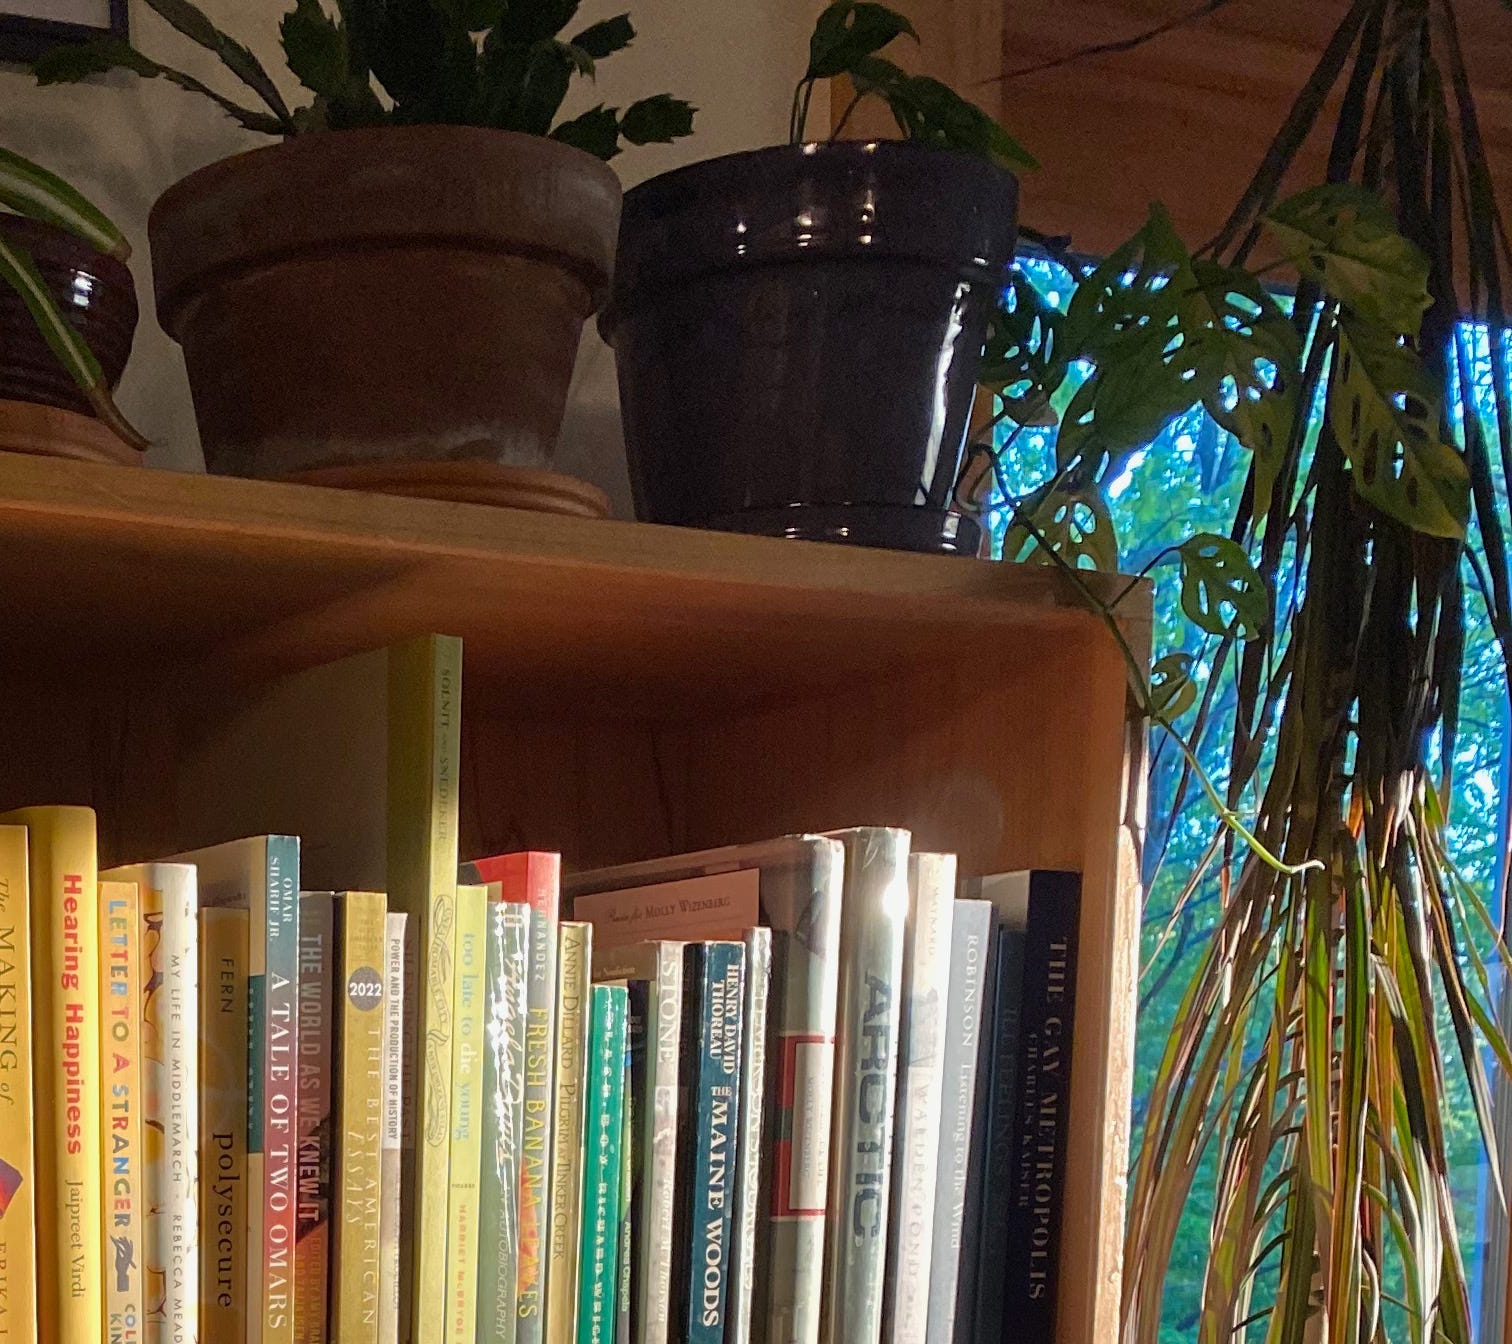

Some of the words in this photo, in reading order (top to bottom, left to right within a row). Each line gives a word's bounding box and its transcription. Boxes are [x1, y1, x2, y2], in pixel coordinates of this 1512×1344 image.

[61, 874, 83, 991] Hearing
[108, 899, 130, 996] LETTER
[271, 972, 290, 995] A
[349, 983, 381, 996] 2022
[110, 1009, 129, 1042] TO
[112, 1053, 131, 1072] A
[270, 1003, 289, 1082] TALE
[0, 1083, 15, 1105] of
[62, 1003, 85, 1155] Happiness
[270, 1094, 289, 1134] OF
[112, 1084, 131, 1228] STRANGER
[270, 1144, 289, 1212] TWO
[708, 1100, 727, 1210] MAINE
[65, 1180, 83, 1249] Jaipreet
[212, 1132, 240, 1308] polysecure
[69, 1254, 85, 1298] Virdi
[268, 1224, 288, 1330] OMARS
[702, 1219, 722, 1326] WOODS
